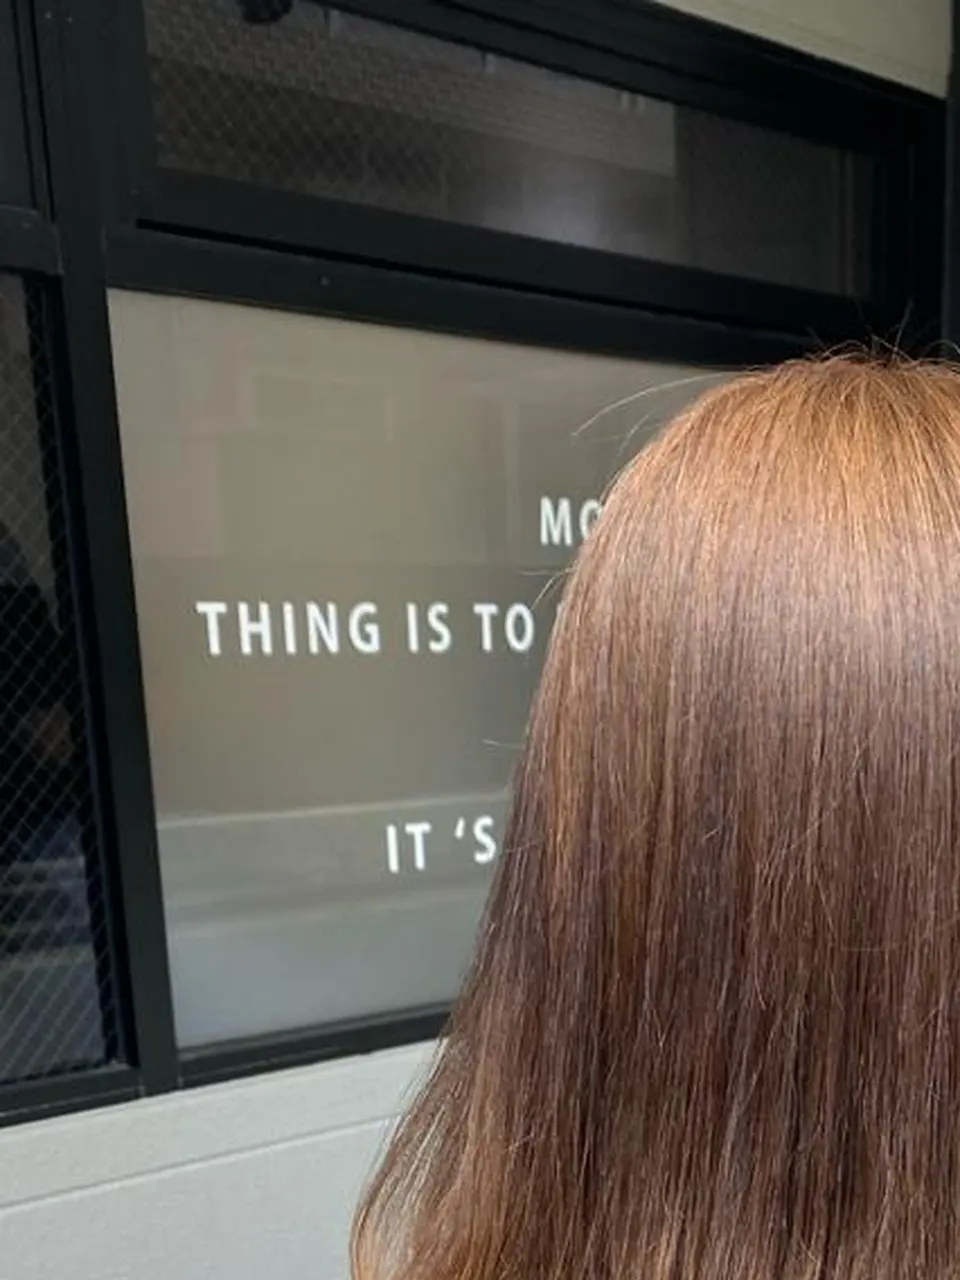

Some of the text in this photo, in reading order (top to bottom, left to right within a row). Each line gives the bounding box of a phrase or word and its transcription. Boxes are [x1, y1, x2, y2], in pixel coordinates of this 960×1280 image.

[195, 601, 534, 656] THING IS TO
[386, 821, 432, 873] IT
